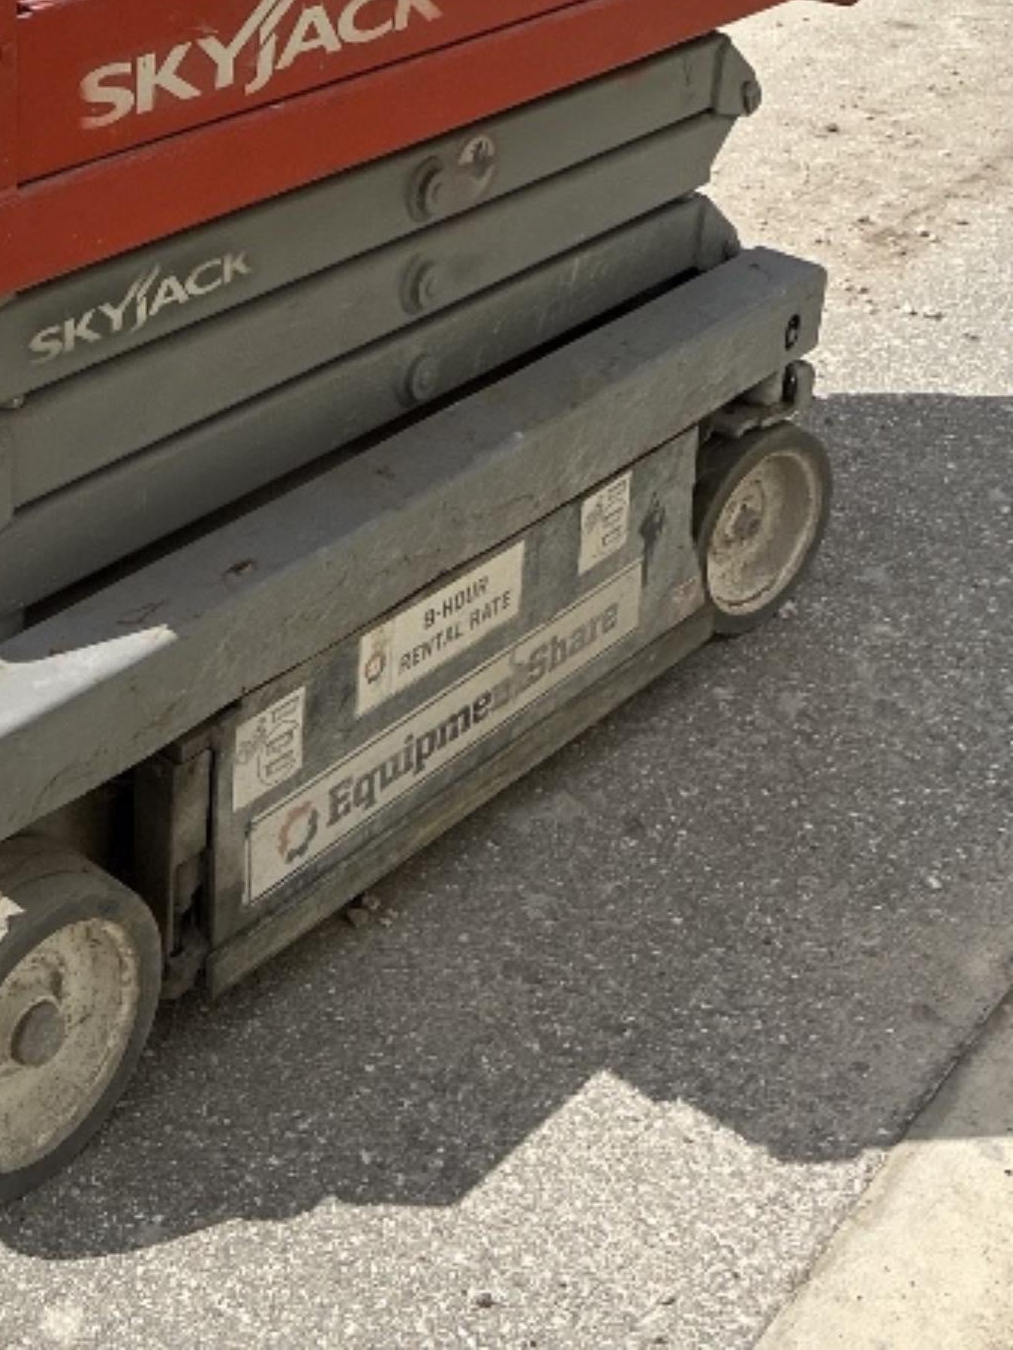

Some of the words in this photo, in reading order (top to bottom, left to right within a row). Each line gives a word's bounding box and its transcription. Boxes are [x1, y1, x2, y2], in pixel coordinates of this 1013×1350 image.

[28, 252, 252, 364] SKYJACK
[399, 623, 464, 674] RENTAL
[469, 590, 511, 631] RATE
[424, 575, 489, 631] 8-HOUR
